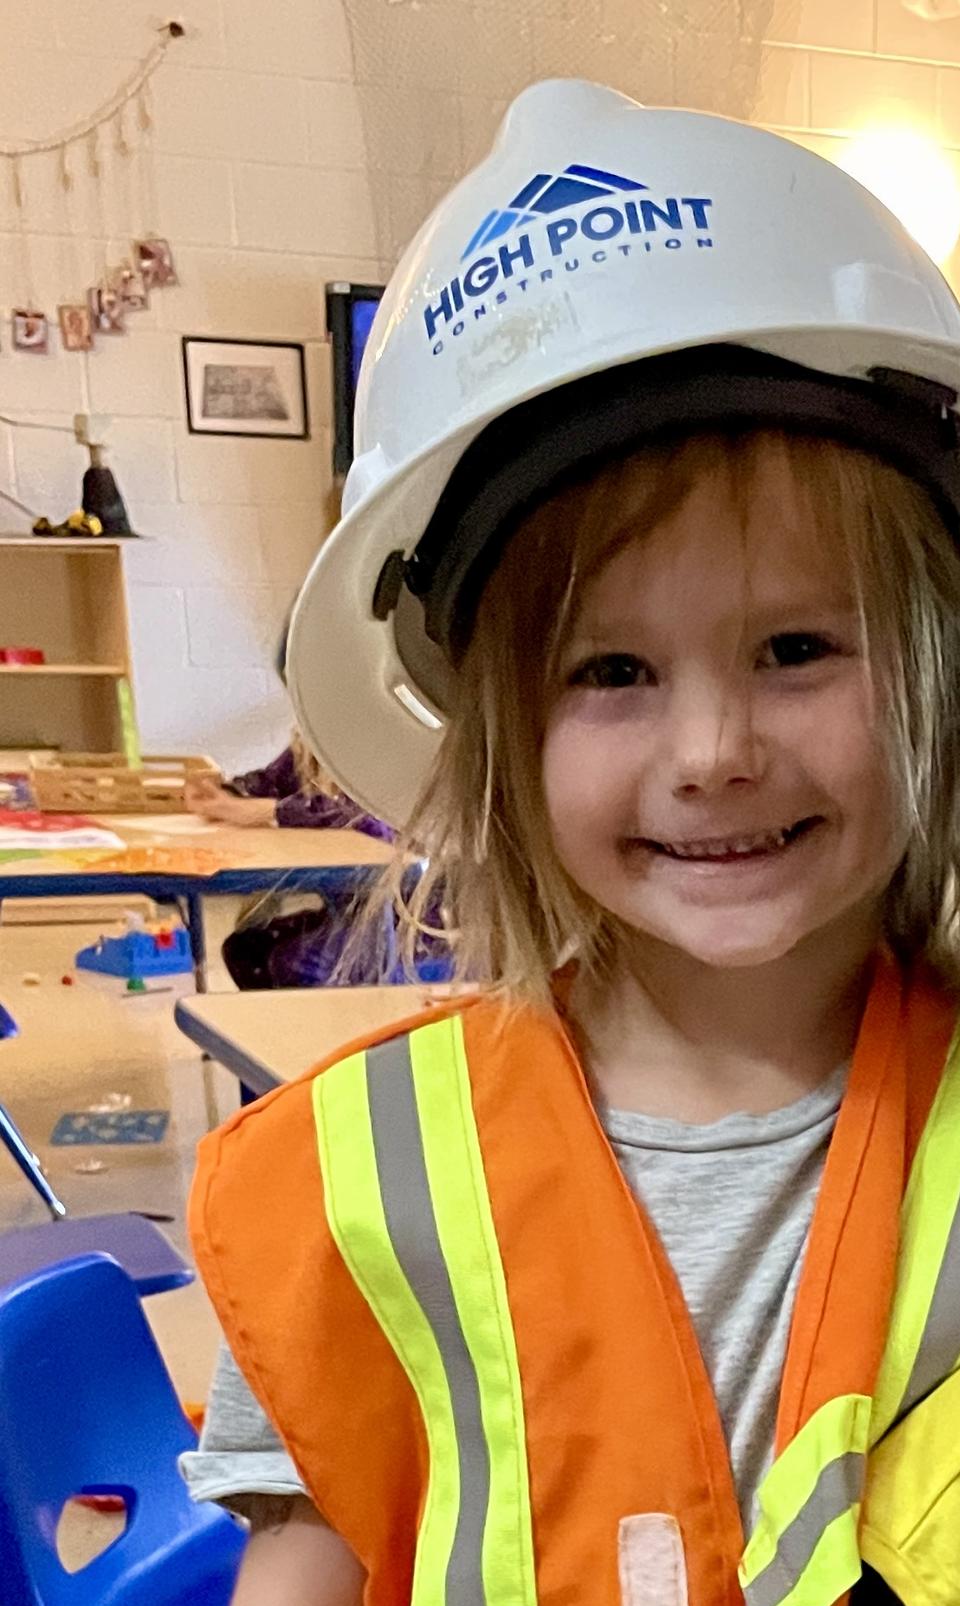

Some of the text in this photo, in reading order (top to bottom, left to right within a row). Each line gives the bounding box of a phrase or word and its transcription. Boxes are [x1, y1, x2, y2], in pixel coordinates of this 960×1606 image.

[423, 198, 712, 340] HIGH POINT
[432, 238, 714, 355] CONSTRUCTION
